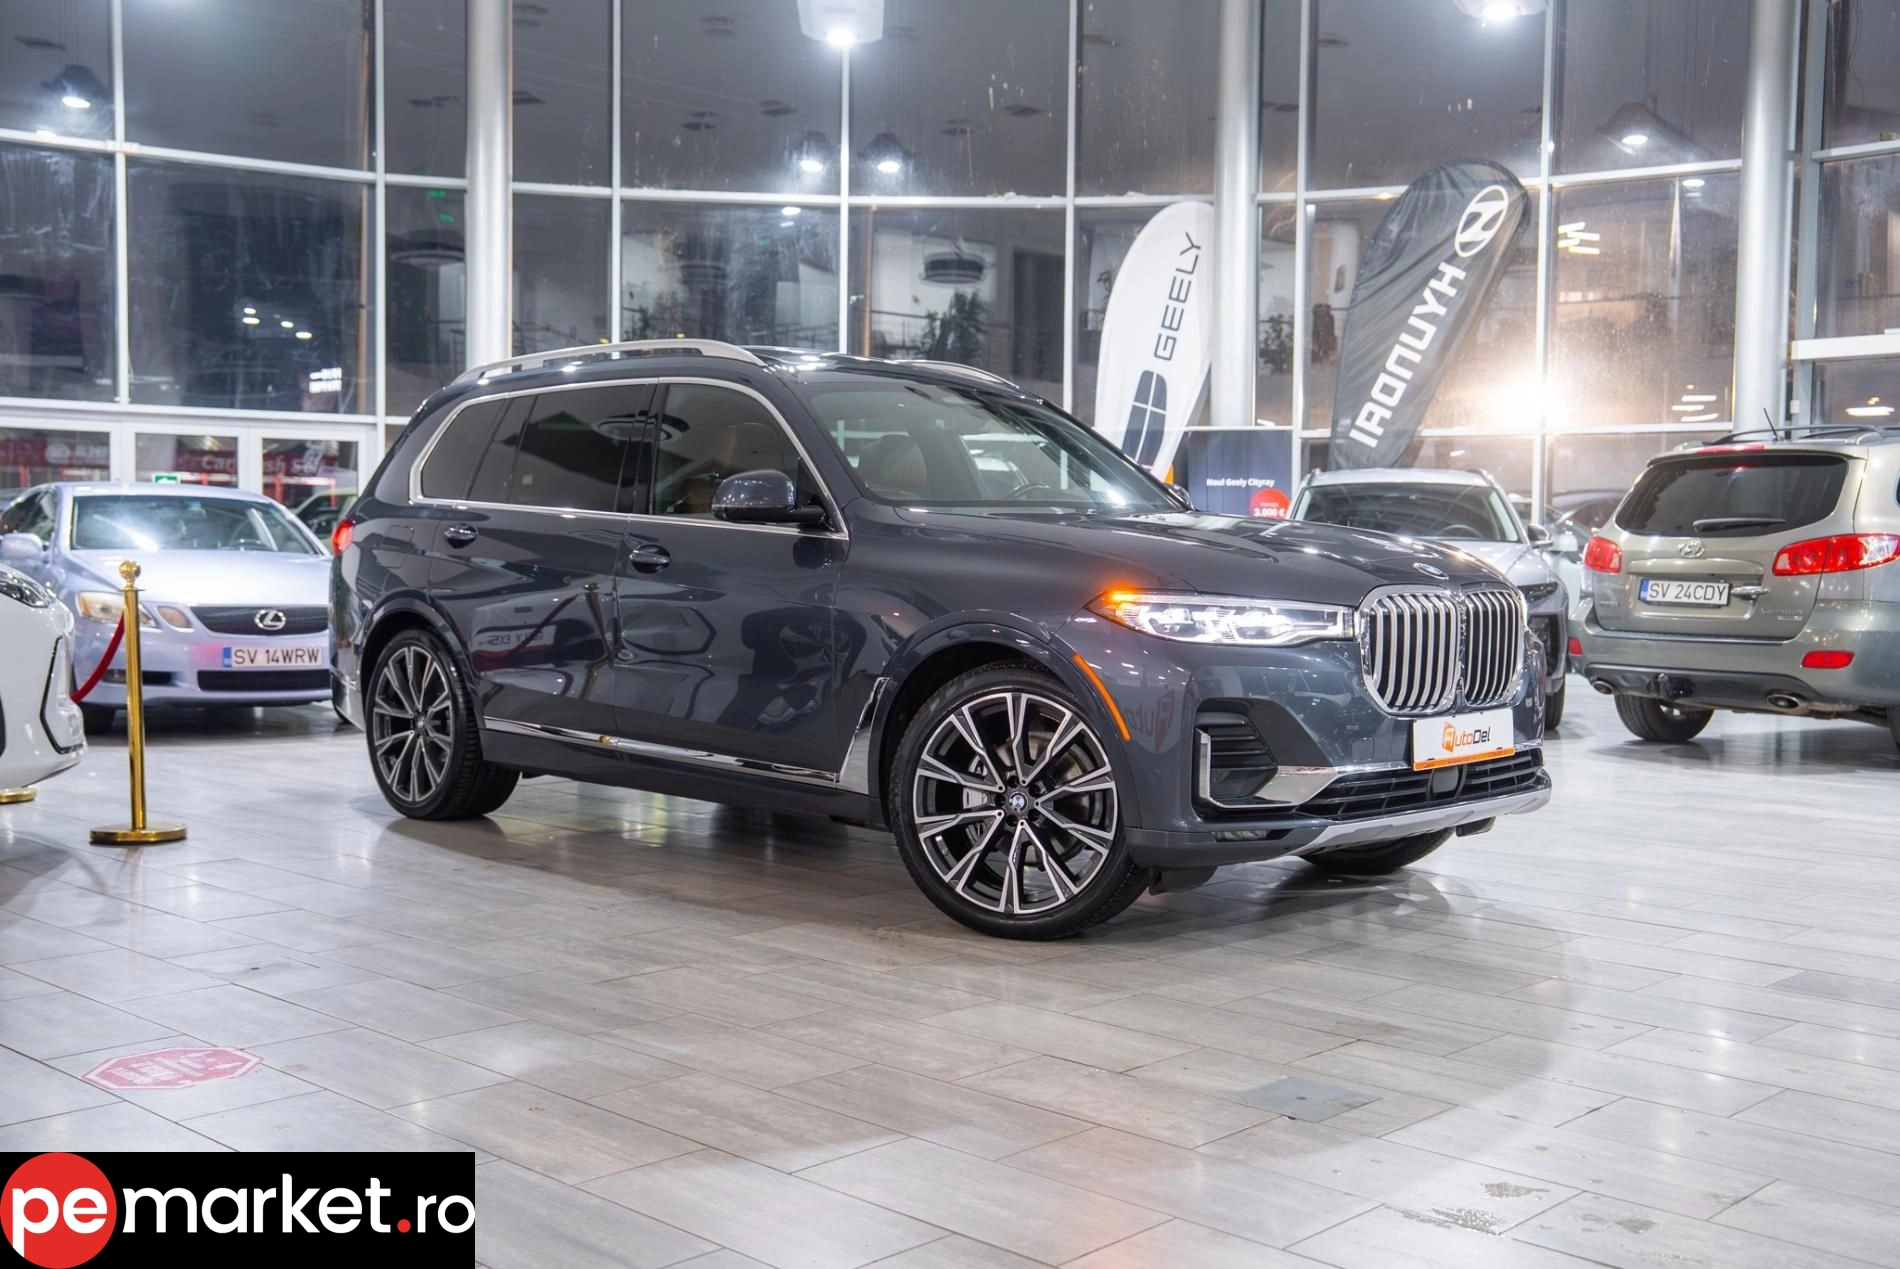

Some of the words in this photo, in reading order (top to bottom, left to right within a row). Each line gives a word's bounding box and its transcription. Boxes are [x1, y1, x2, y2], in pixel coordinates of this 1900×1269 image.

[1153, 231, 1202, 361] GEELY
[1226, 478, 1247, 488] Geely
[1649, 583, 1671, 599] SV
[1675, 583, 1727, 601] 24CDY
[233, 648, 258, 665] SV
[265, 647, 320, 665] 14WRW
